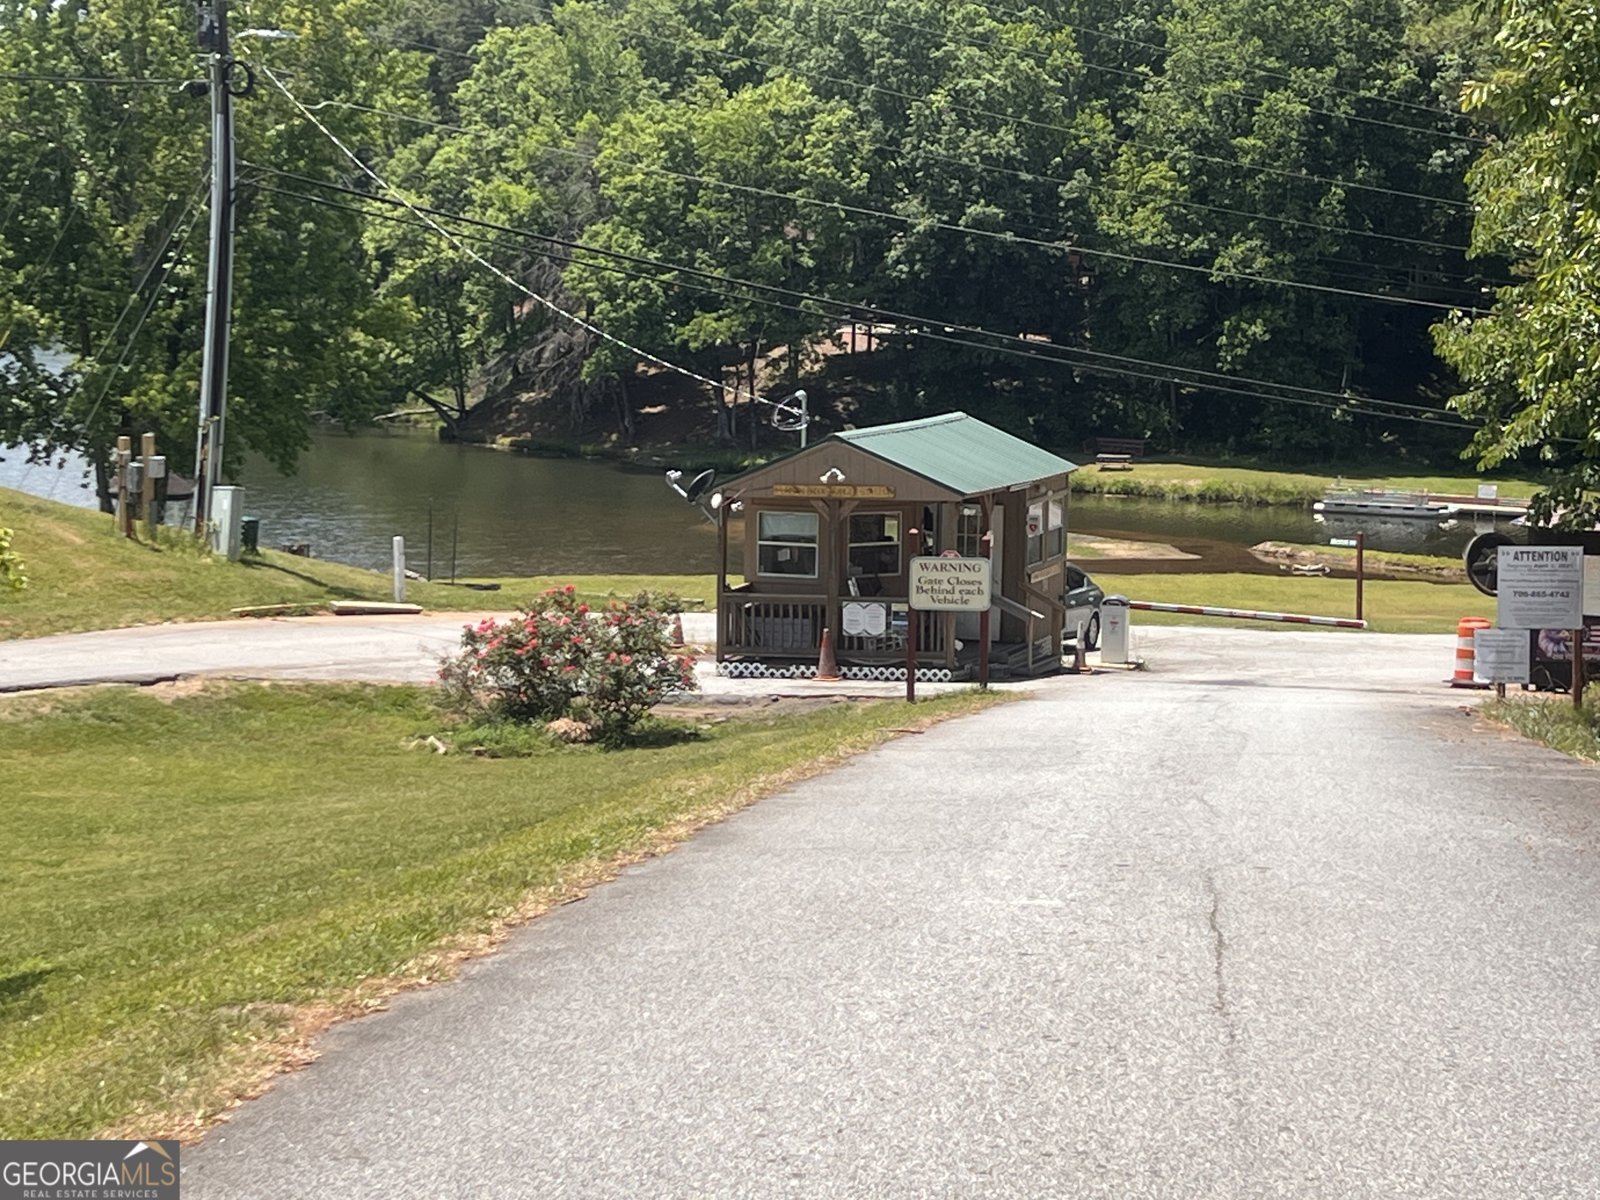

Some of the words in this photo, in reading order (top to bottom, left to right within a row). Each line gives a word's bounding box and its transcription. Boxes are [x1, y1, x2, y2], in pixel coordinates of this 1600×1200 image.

[1513, 550, 1568, 561] ATTENTION
[919, 562, 982, 573] WARNING
[917, 576, 944, 585] Gate
[947, 577, 983, 586] Closes
[916, 586, 955, 595] Behind
[958, 587, 984, 596] each
[930, 596, 970, 605] Vehicle
